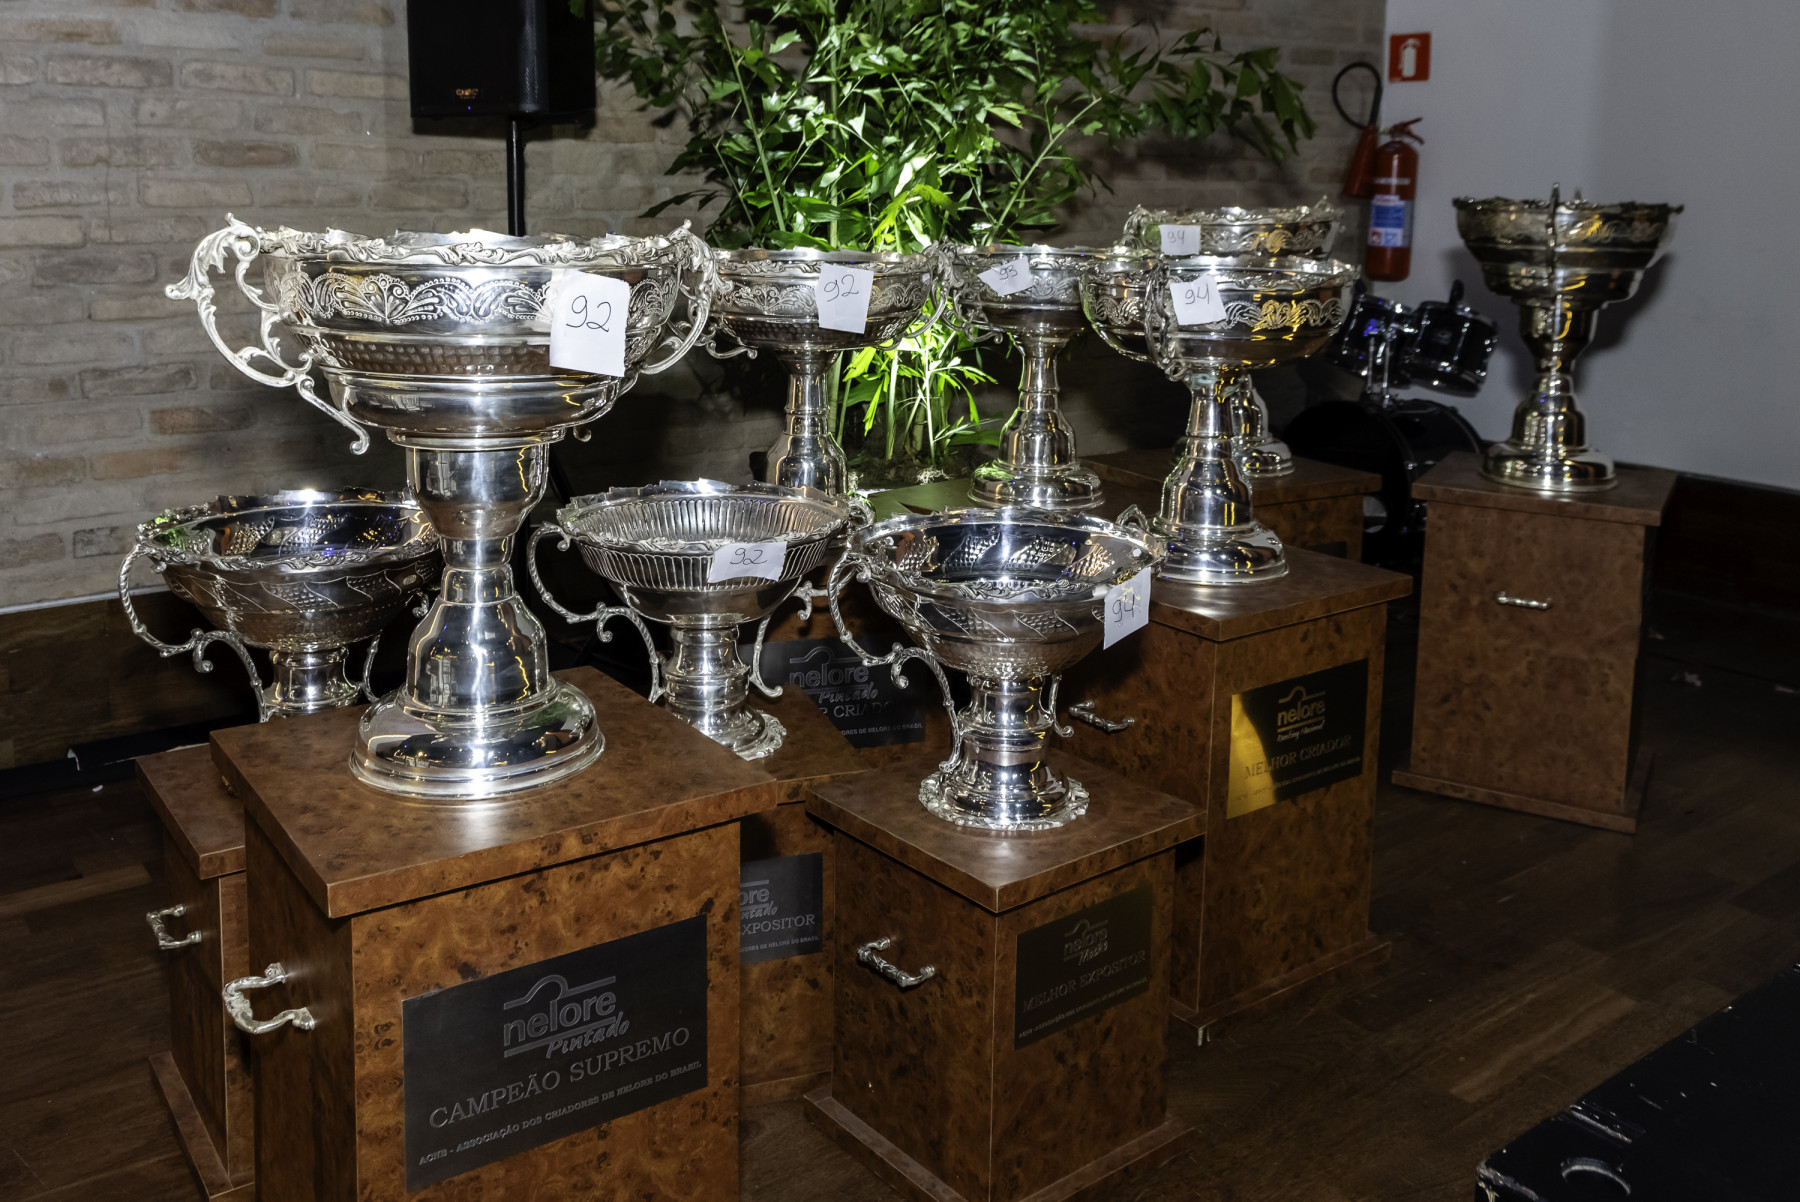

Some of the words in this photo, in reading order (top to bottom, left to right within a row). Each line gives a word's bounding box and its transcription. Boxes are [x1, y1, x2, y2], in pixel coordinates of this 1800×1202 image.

[1167, 230, 1185, 244] 94
[999, 265, 1018, 281] 93
[824, 274, 859, 302] 92
[1185, 282, 1210, 305] 94
[566, 295, 612, 332] 92
[730, 547, 768, 565] 92
[1112, 594, 1135, 623] 94
[789, 663, 869, 689] nelore
[1277, 700, 1325, 726] nelore
[1244, 751, 1297, 779] MELHOR
[1300, 735, 1352, 761] CRIADOR
[740, 888, 770, 906] ore
[741, 900, 778, 920] ntado
[741, 914, 816, 936] XPOSITOR
[1064, 928, 1108, 955] nelore
[1022, 979, 1077, 1013] MELHOR
[1080, 950, 1146, 989] EXPOSITOR
[504, 991, 617, 1047] nelore
[546, 1011, 630, 1058] Pintado
[429, 1070, 561, 1128] CAMPEÃO
[569, 1027, 690, 1083] SUPREMO
[456, 1123, 520, 1153] ASSOCIAÇÃO
[522, 1115, 543, 1130] DOS
[545, 1096, 600, 1120] CRIADORES
[601, 1090, 615, 1103] DE
[616, 1076, 654, 1096] NELORE
[655, 1071, 669, 1082] DO
[670, 1060, 702, 1078] BRASIL
